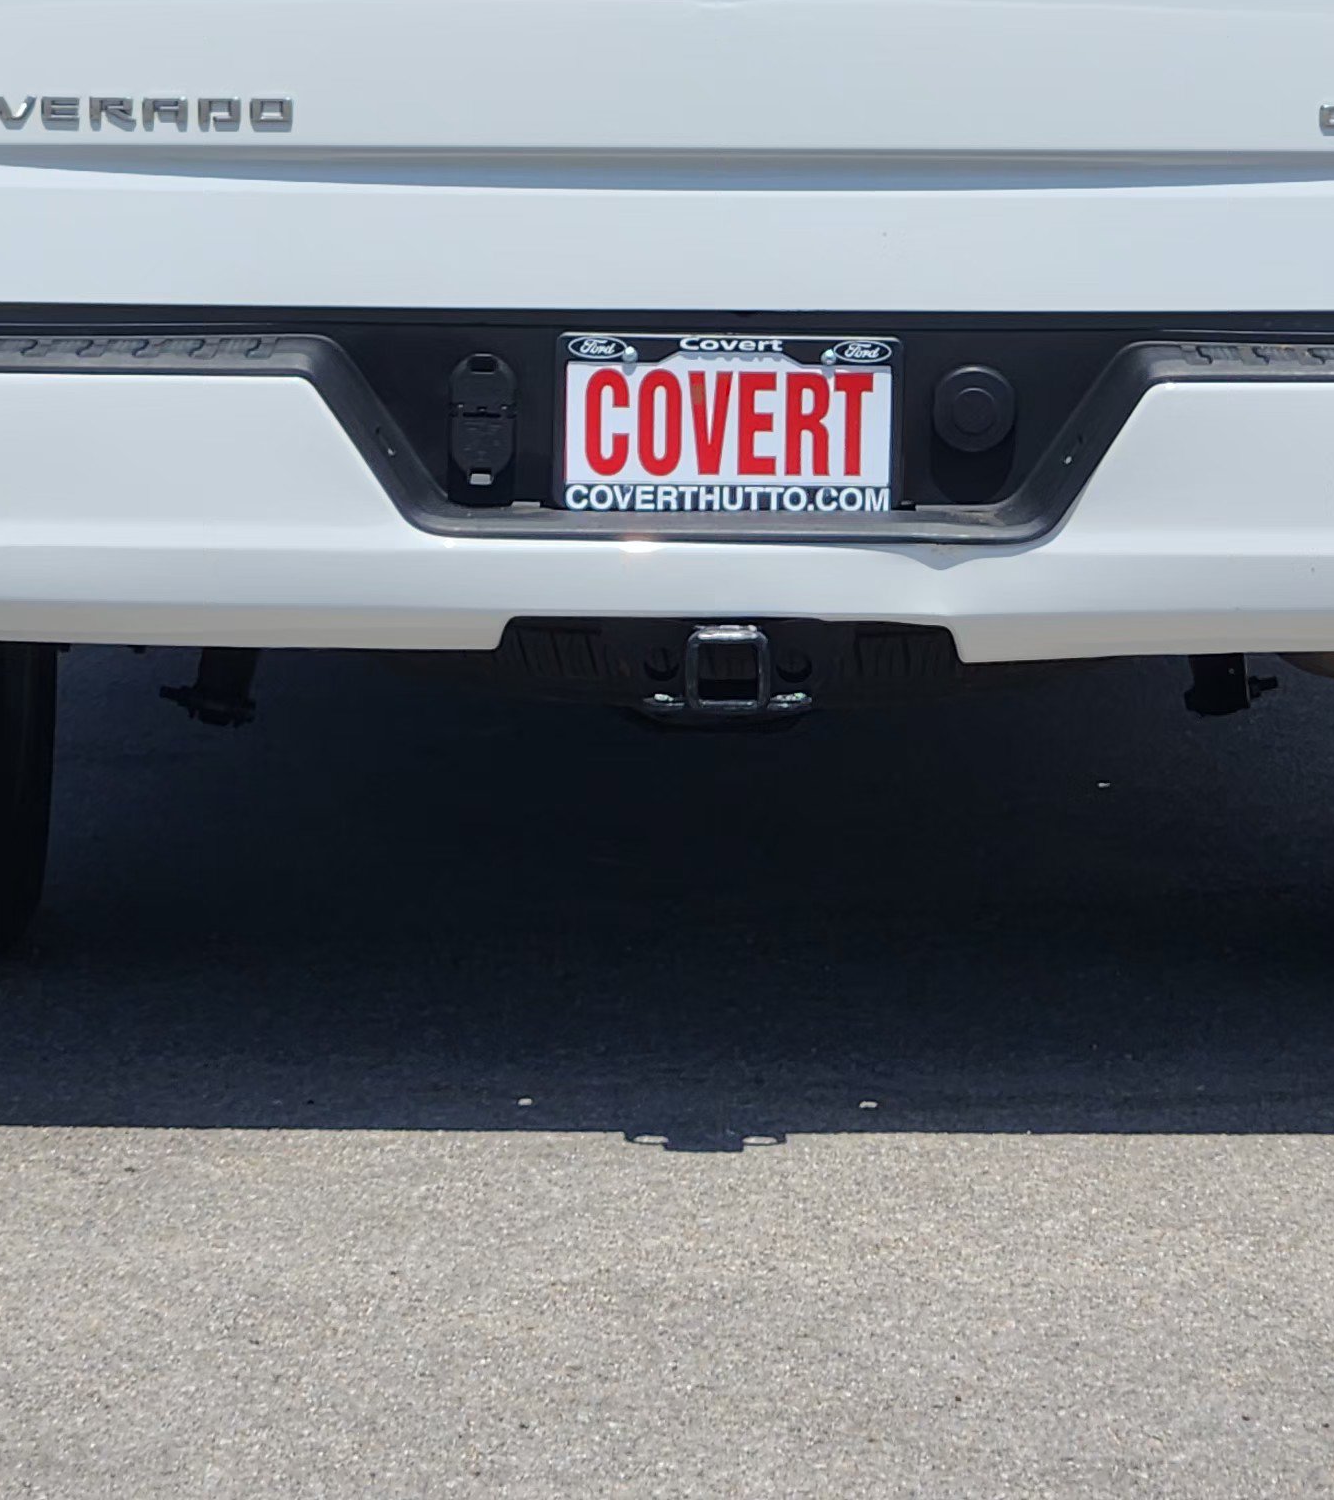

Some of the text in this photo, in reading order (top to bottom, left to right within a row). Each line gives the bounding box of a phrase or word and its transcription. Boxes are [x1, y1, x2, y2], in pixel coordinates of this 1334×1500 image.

[580, 338, 616, 355] Ford
[679, 336, 783, 352] Covert
[844, 342, 880, 359] Ford
[585, 368, 874, 477] COVERT
[566, 485, 890, 512] COVERTHUTTO.COM
